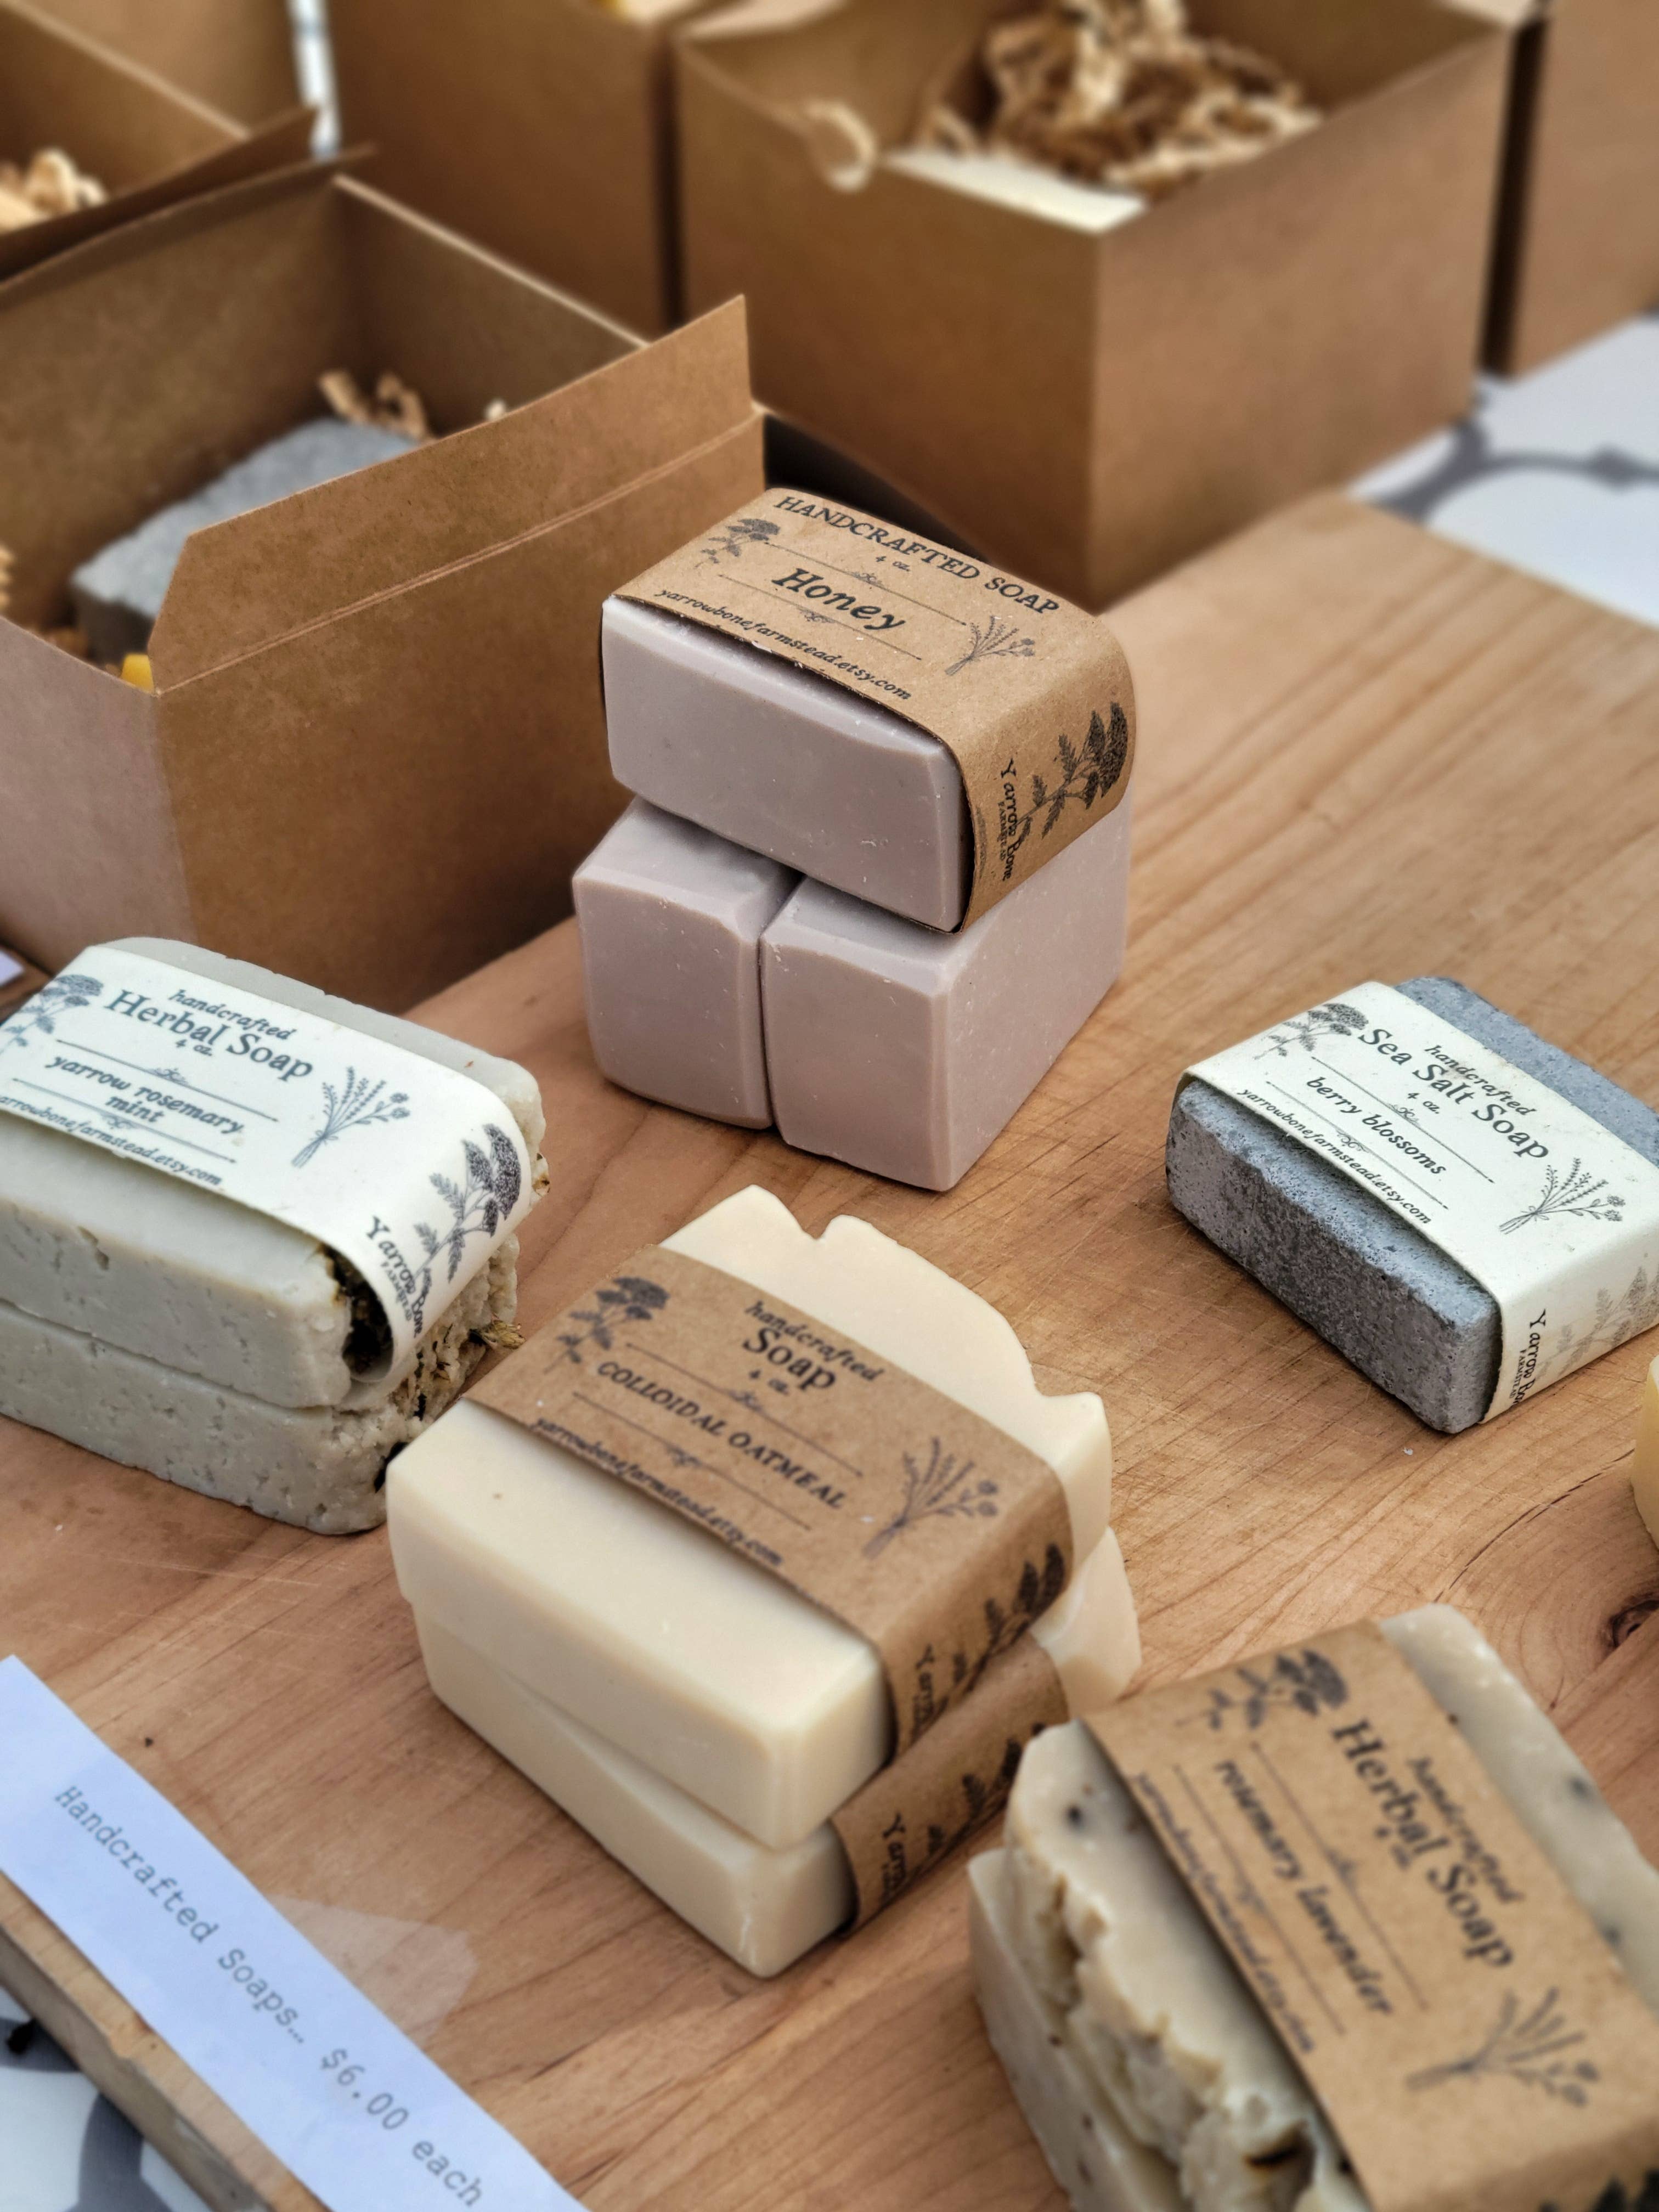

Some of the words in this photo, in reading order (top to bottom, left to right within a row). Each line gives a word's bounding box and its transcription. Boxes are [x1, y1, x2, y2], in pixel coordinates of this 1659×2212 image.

[774, 496, 981, 581] HANDCRAFTED
[985, 577, 1060, 616] SOAP
[773, 568, 906, 633] Honey
[655, 588, 911, 700] yarrowbonefarmstead.etsy.com
[1001, 758, 1018, 836] Yarrow
[1003, 840, 1020, 881] Bone
[104, 989, 220, 1047] Herbal
[226, 1033, 313, 1082] Soap
[168, 989, 297, 1041] handcrafted
[176, 1039, 186, 1048] 4
[45, 1054, 132, 1091] yarrow
[134, 1085, 244, 1135] rosemary
[106, 1094, 165, 1126] mint
[1358, 1028, 1412, 1066] Sea
[1413, 1064, 1474, 1107] Salt
[1471, 1103, 1549, 1161] Soap
[1407, 1092, 1417, 1100] 4
[1423, 1101, 1440, 1114] oz.
[1425, 1045, 1536, 1116] handcrafted
[0, 1097, 222, 1185] arrowbonefarmstead.etsy.com
[1237, 1087, 1432, 1224] yarrowbonefarmstead.etsy.com
[1307, 1076, 1361, 1116] berry
[1362, 1114, 1447, 1175] blossoms
[366, 1215, 415, 1294] Yarrow
[742, 1326, 836, 1393] Soap
[746, 1301, 884, 1382] handcrafted
[1523, 1309, 1545, 1379] Yarrow
[1514, 1379, 1536, 1404] Bon
[596, 1359, 724, 1437] COLLOIDAL
[728, 1431, 847, 1510] OATMEAL
[1331, 1718, 1451, 1858] Herbal
[1428, 1863, 1514, 1968] Soap
[1215, 1758, 1304, 1882] rosemary
[1297, 1883, 1392, 2015] lavender
[54, 1786, 219, 1943] Handcrafted
[320, 2047, 408, 2130] $6.00
[411, 2138, 482, 2207] each
